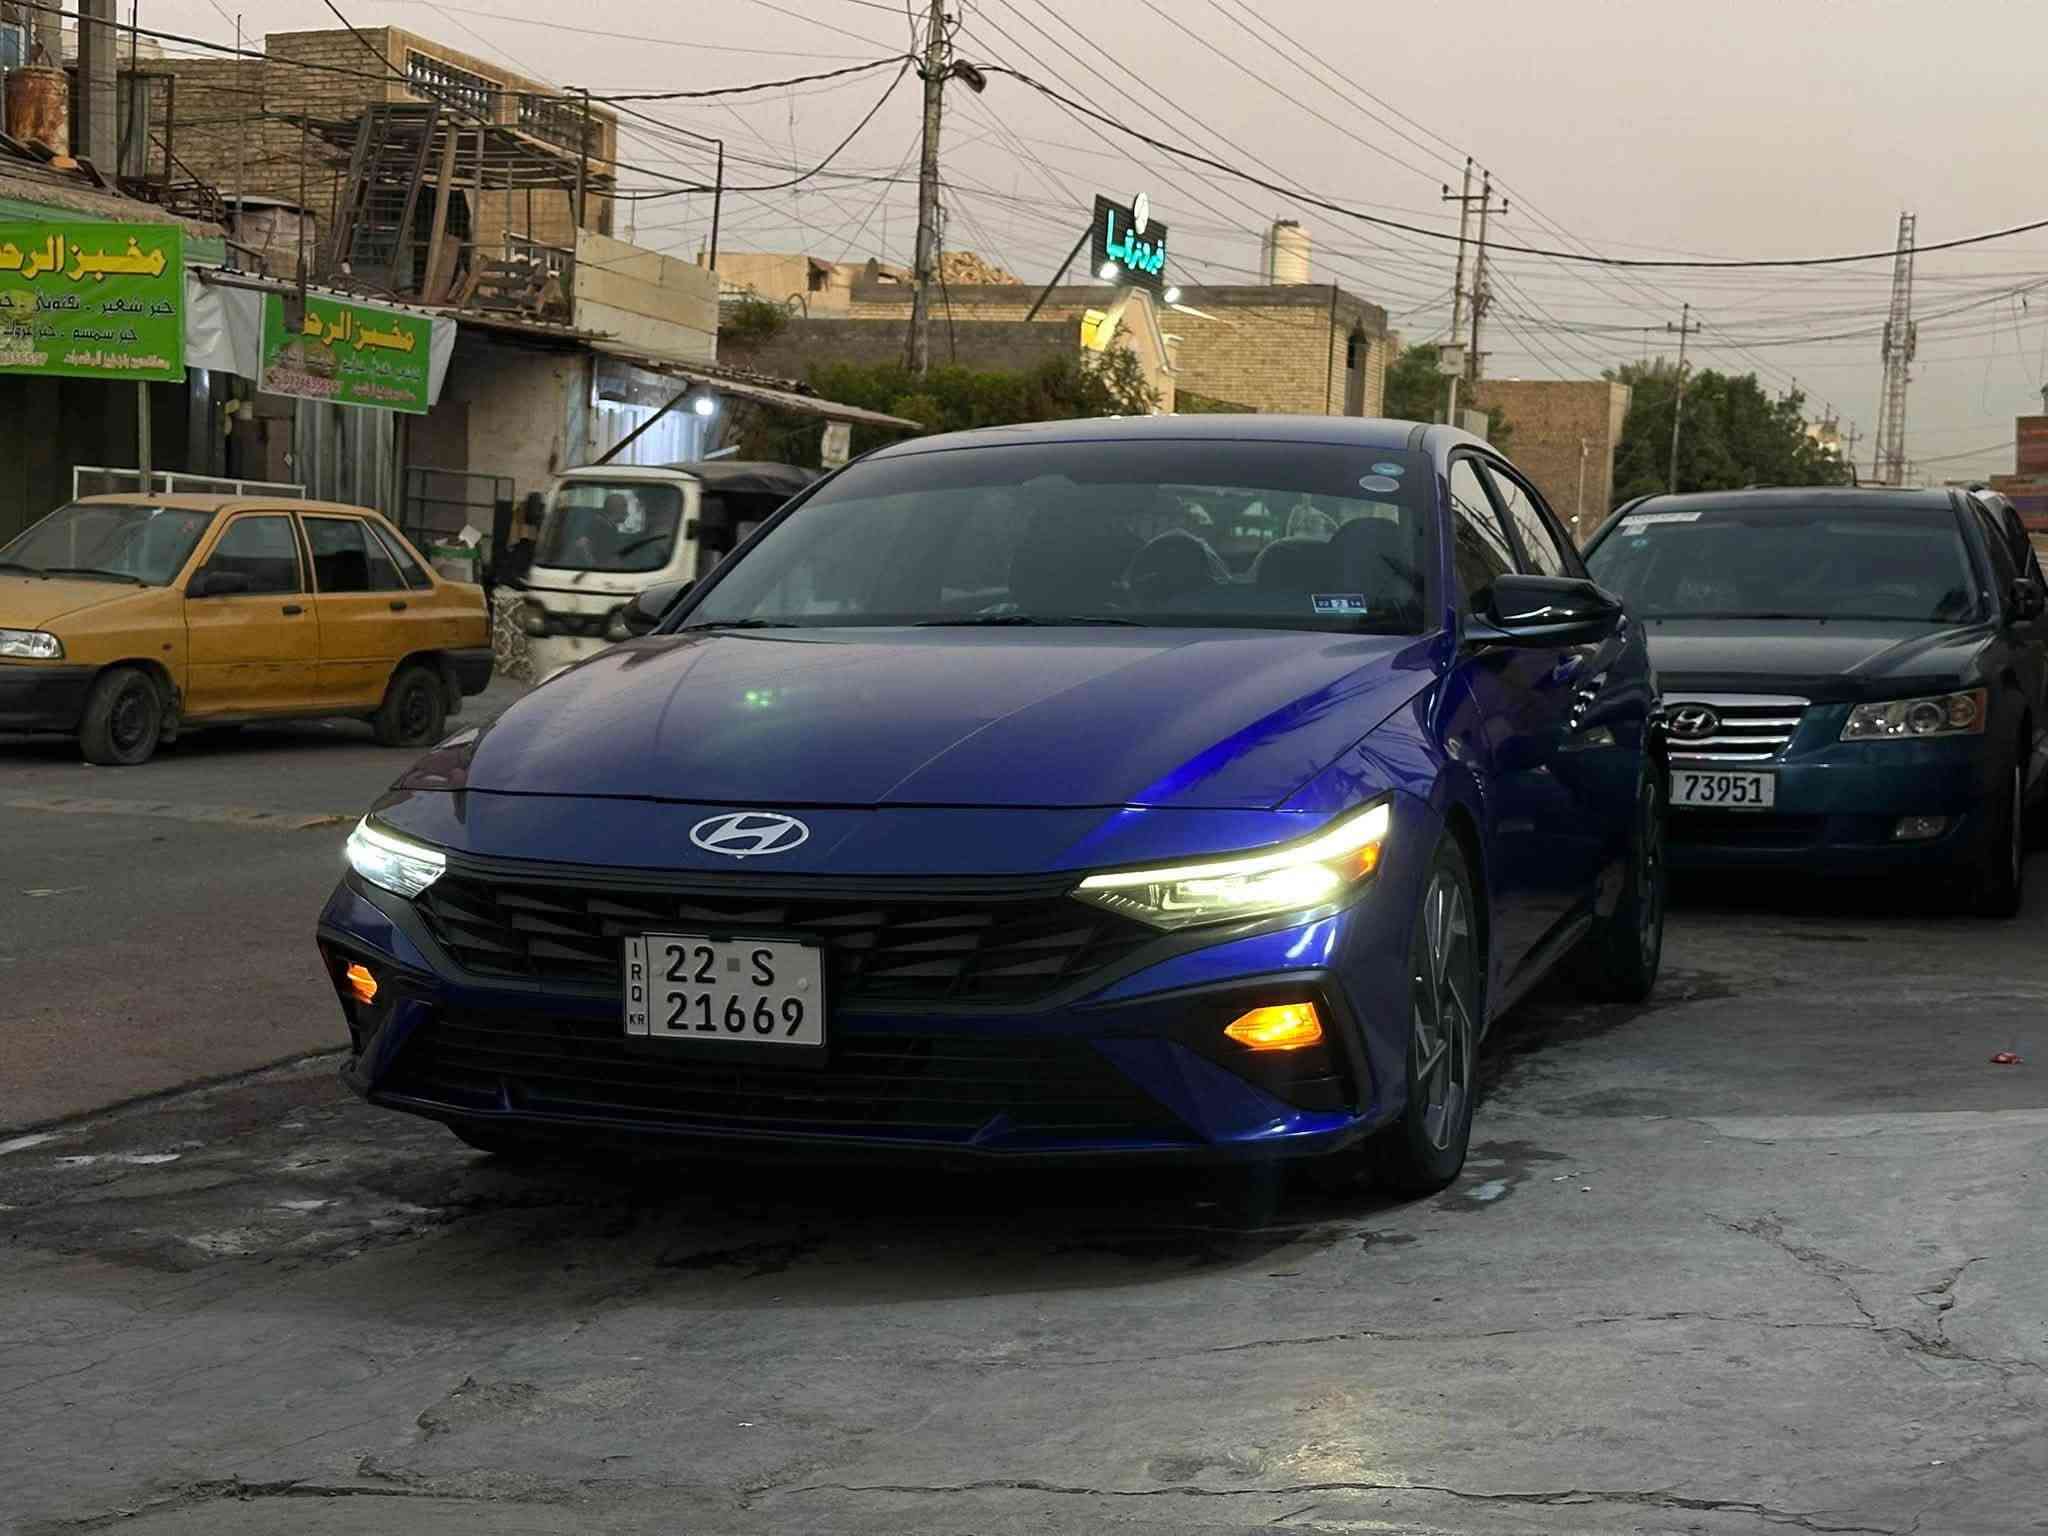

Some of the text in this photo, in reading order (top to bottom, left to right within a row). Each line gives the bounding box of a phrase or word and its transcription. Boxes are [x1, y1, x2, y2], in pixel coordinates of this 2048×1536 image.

[66, 235, 168, 281] مخبز
[353, 319, 416, 353] مخبز
[1684, 775, 1763, 804] 73951
[665, 944, 775, 987] 22 S
[629, 1013, 645, 1026] KR
[666, 991, 805, 1037] 21669
